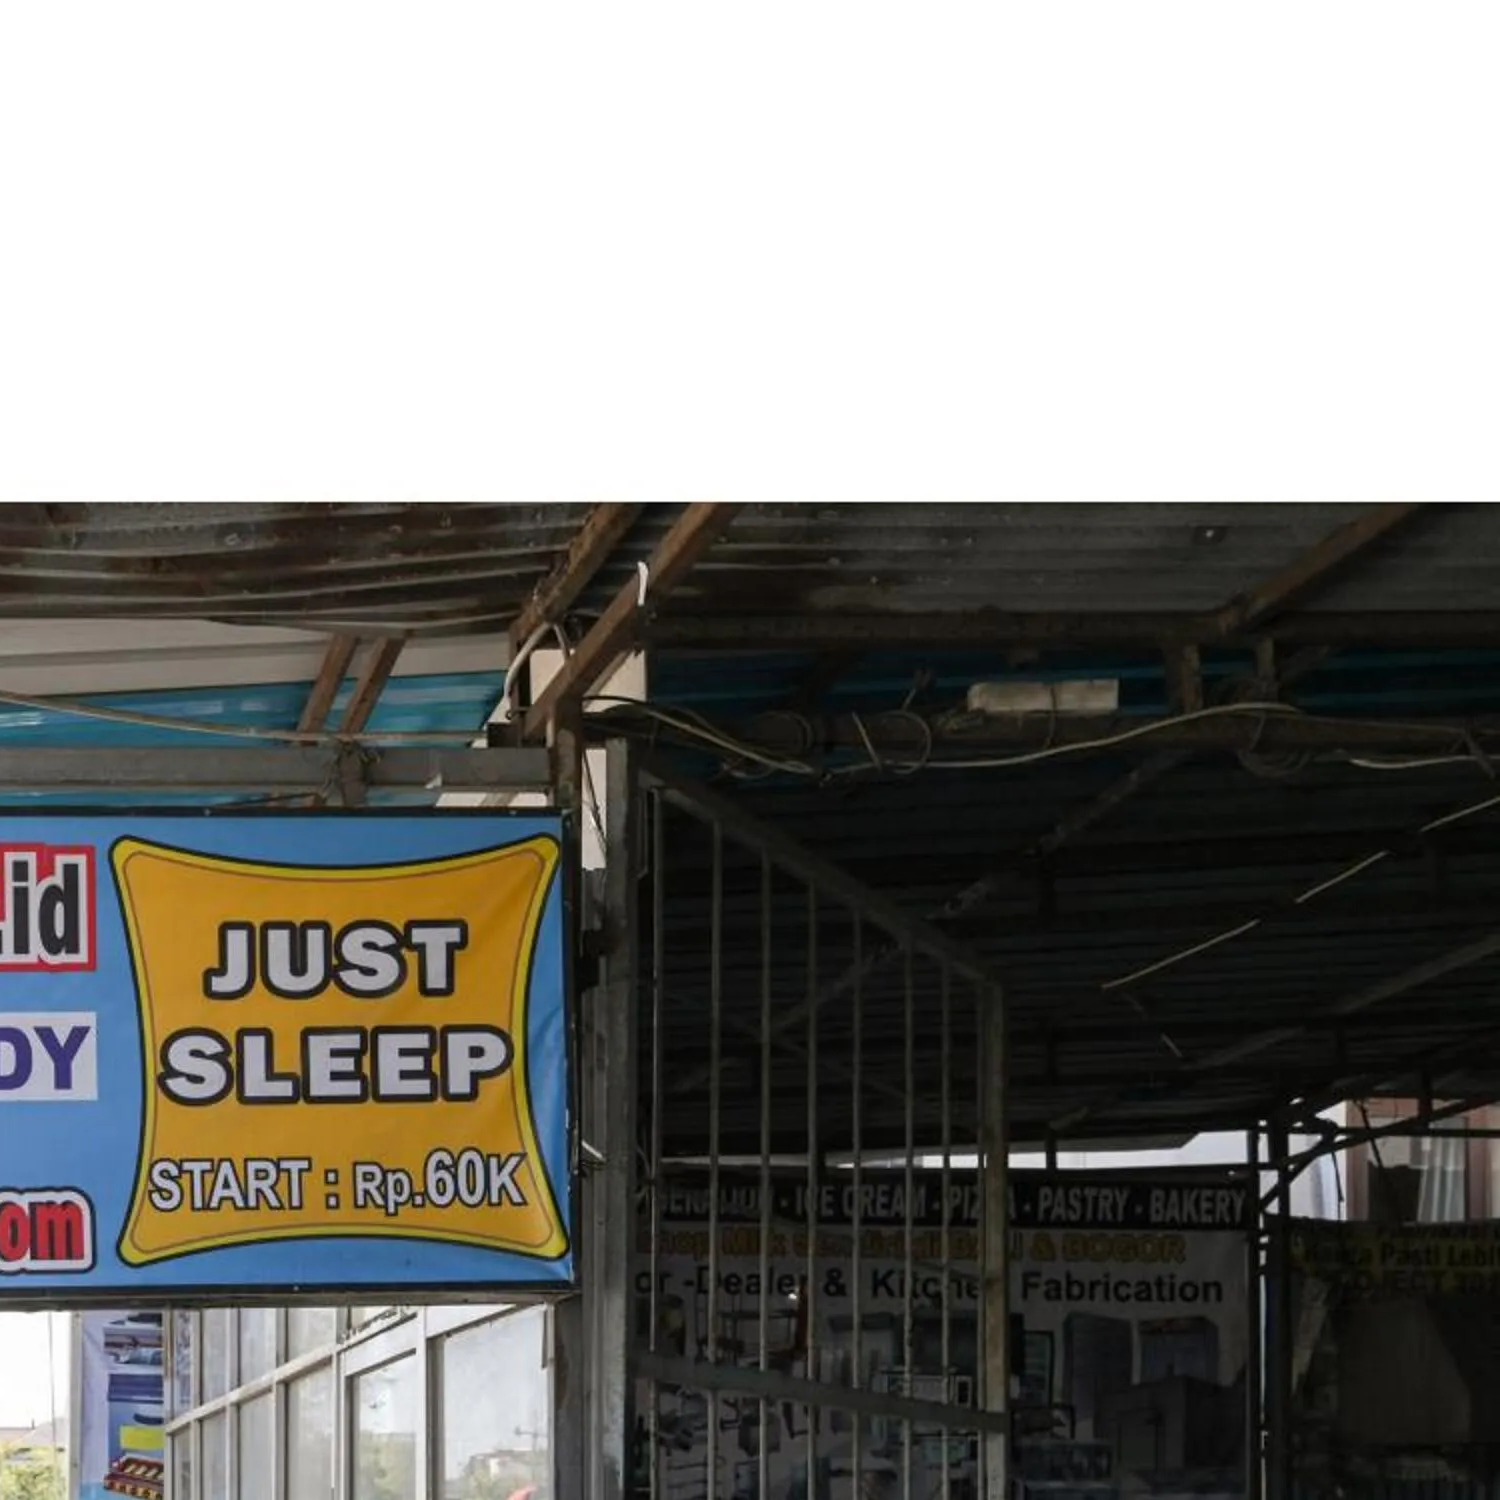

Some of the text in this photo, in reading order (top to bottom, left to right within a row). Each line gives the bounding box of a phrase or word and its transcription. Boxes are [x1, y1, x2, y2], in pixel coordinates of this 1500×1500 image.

[203, 920, 468, 998] JUST
[158, 1024, 515, 1104] SLEEP
[148, 1157, 311, 1211] START
[352, 1148, 528, 1216] Rp.60K
[1037, 1184, 1130, 1223] PASTRY
[1149, 1187, 1247, 1225] BAKERY
[823, 1267, 848, 1297] &
[871, 1267, 982, 1300] Kitche
[1021, 1270, 1223, 1303] Fabrication
